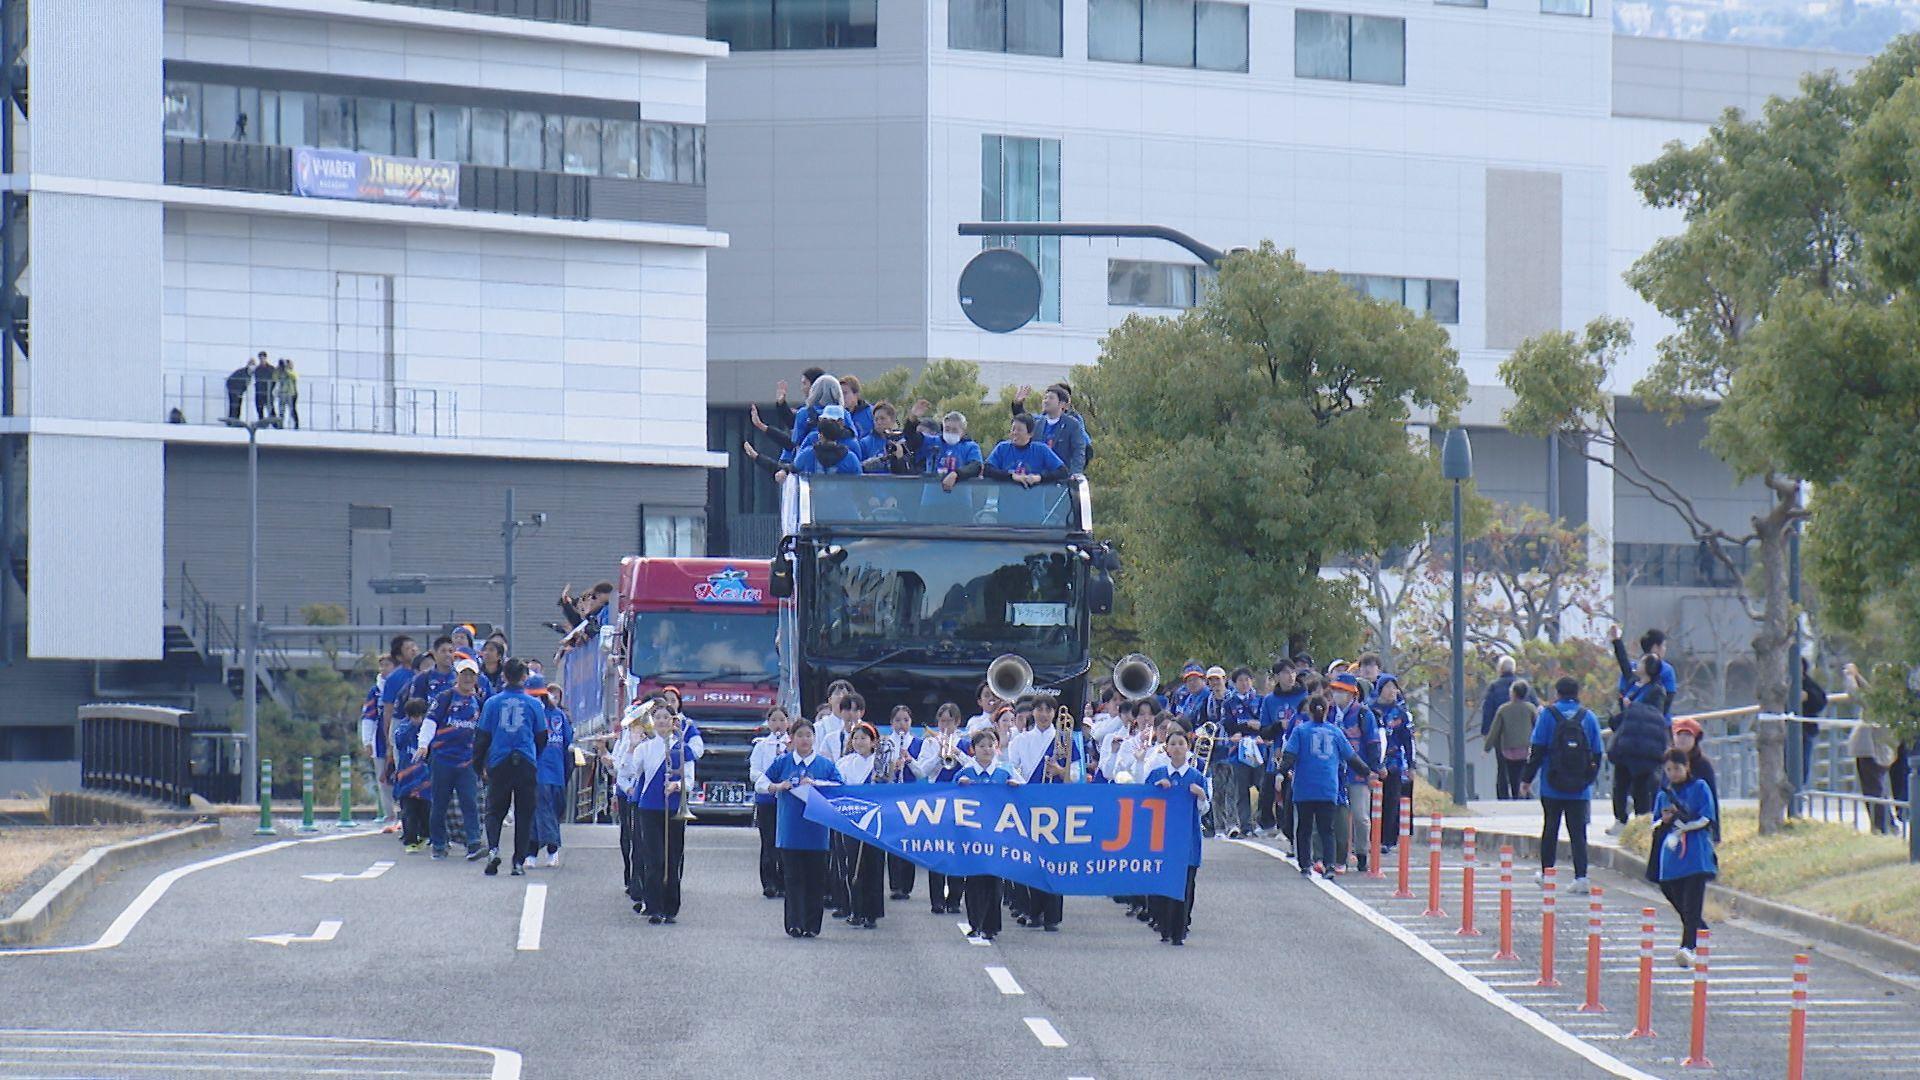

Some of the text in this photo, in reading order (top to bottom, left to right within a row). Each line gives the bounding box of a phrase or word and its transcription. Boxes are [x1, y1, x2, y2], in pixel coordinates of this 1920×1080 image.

[312, 157, 356, 179] V-VAREN
[703, 692, 751, 704] ISUZU
[896, 798, 1167, 852] WE ARE J1
[900, 839, 1165, 876] THANK YOU FOR YOUR SUPPORT
